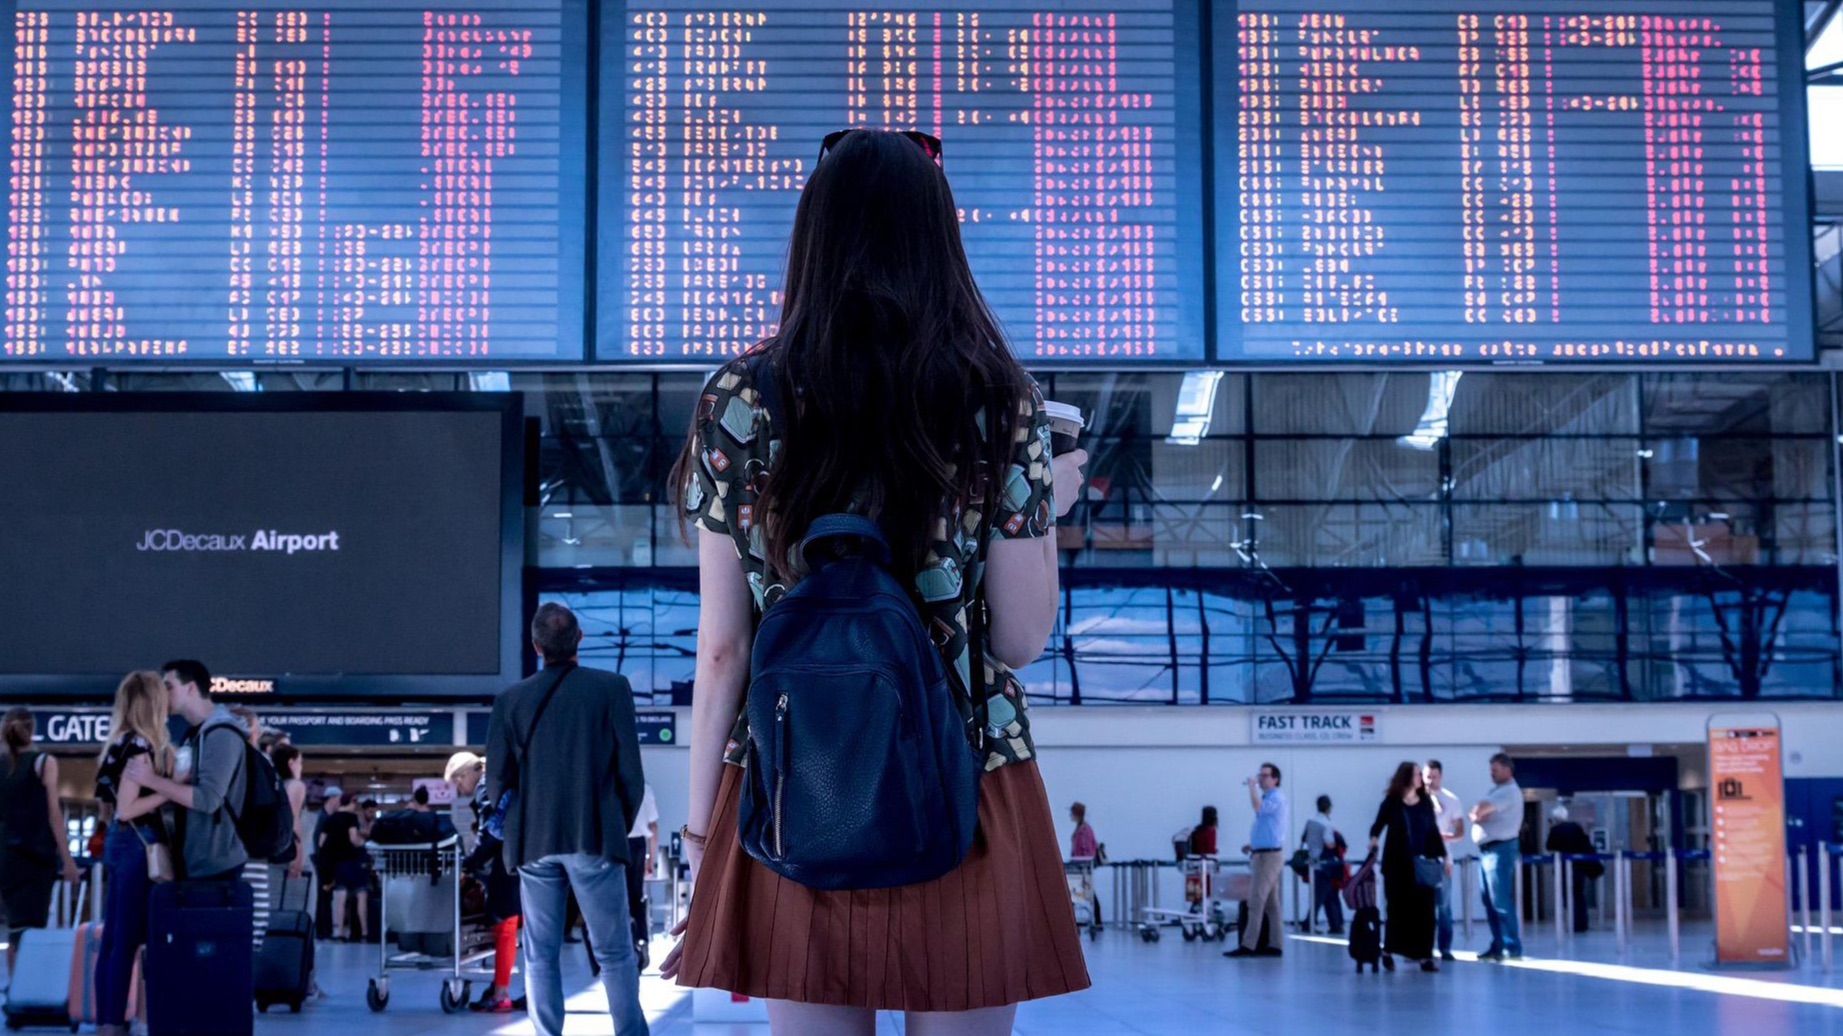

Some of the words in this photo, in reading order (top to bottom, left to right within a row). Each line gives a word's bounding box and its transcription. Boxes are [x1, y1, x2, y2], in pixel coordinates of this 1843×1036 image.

[136, 529, 245, 551] JCDecaux
[251, 529, 339, 554] Airport
[47, 714, 111, 742] GATE
[288, 716, 327, 726] PASSPORT
[327, 716, 344, 725] AND
[345, 716, 383, 726] BOARDING
[403, 716, 429, 725] READY
[1258, 715, 1296, 729] FAST
[1301, 715, 1352, 729] TRACK
